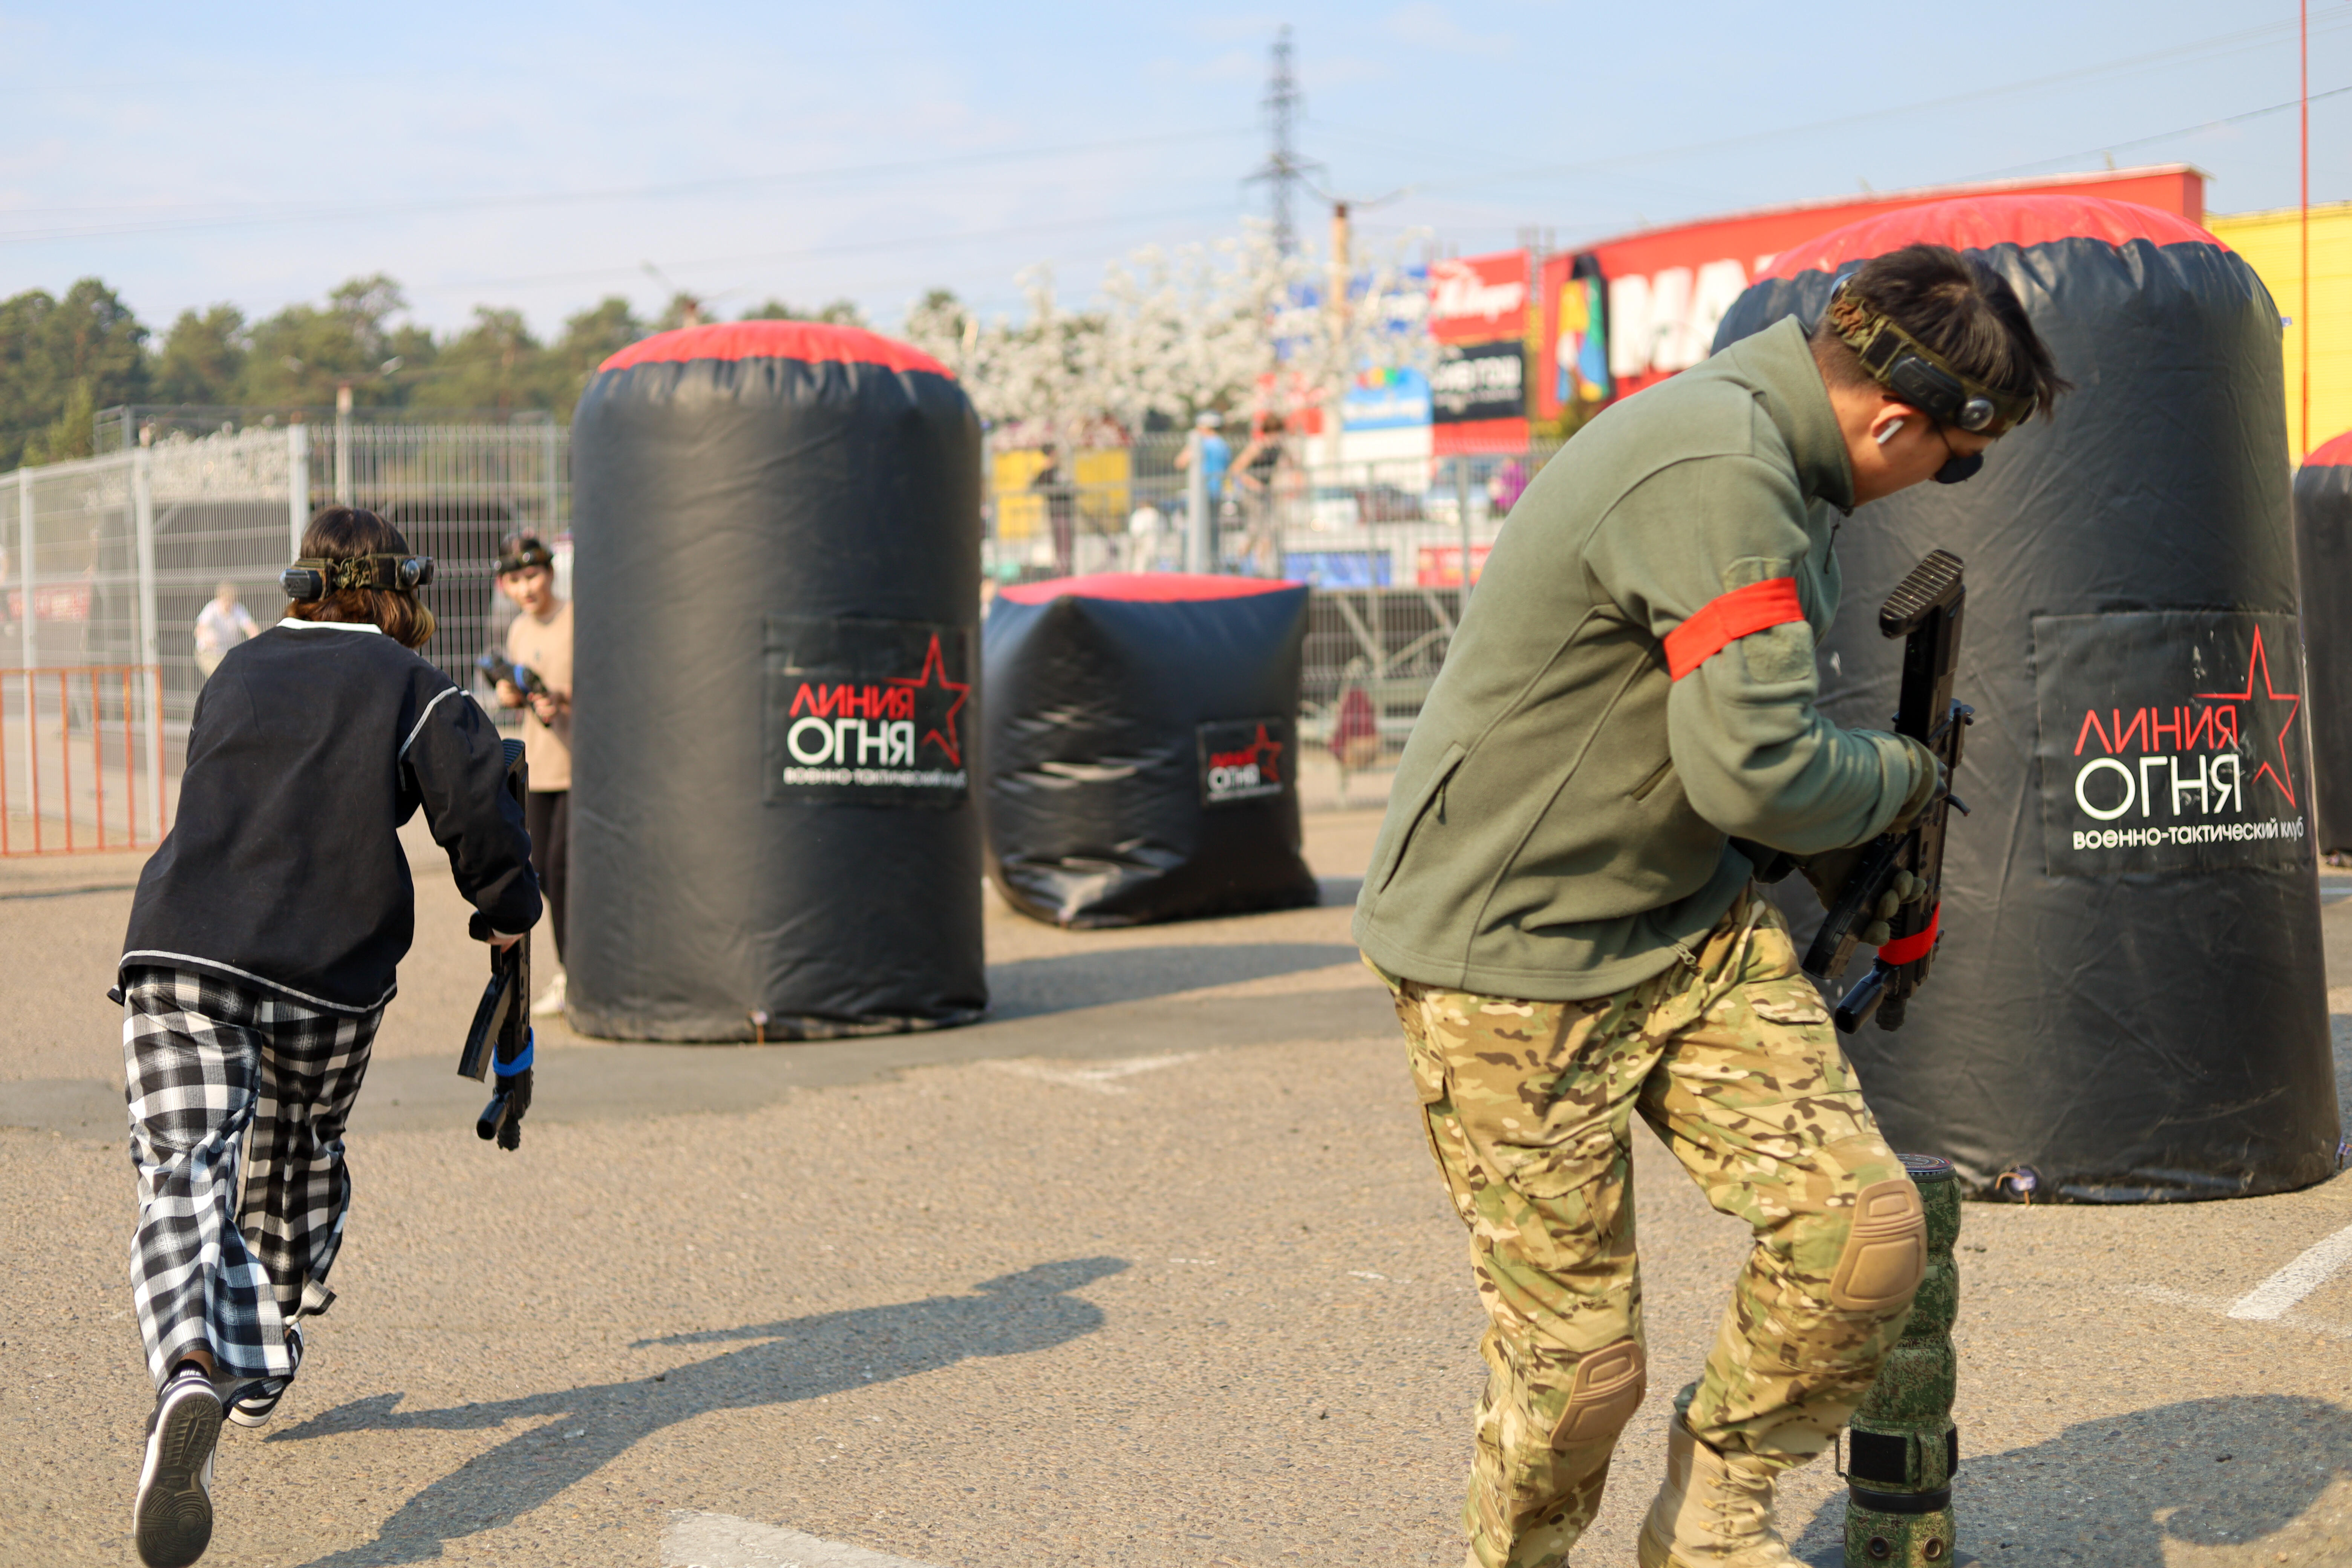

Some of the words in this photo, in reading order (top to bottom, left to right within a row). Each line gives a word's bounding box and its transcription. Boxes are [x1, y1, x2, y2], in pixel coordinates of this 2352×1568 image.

[789, 682, 915, 720] ЛИНИЯ
[787, 716, 915, 767] ОГНЯ
[2074, 705, 2238, 756] ЛИНИЯ
[2075, 753, 2242, 821] ОГНЯ
[2073, 817, 2278, 850] военно-тактический
[2280, 815, 2304, 842] клуб
